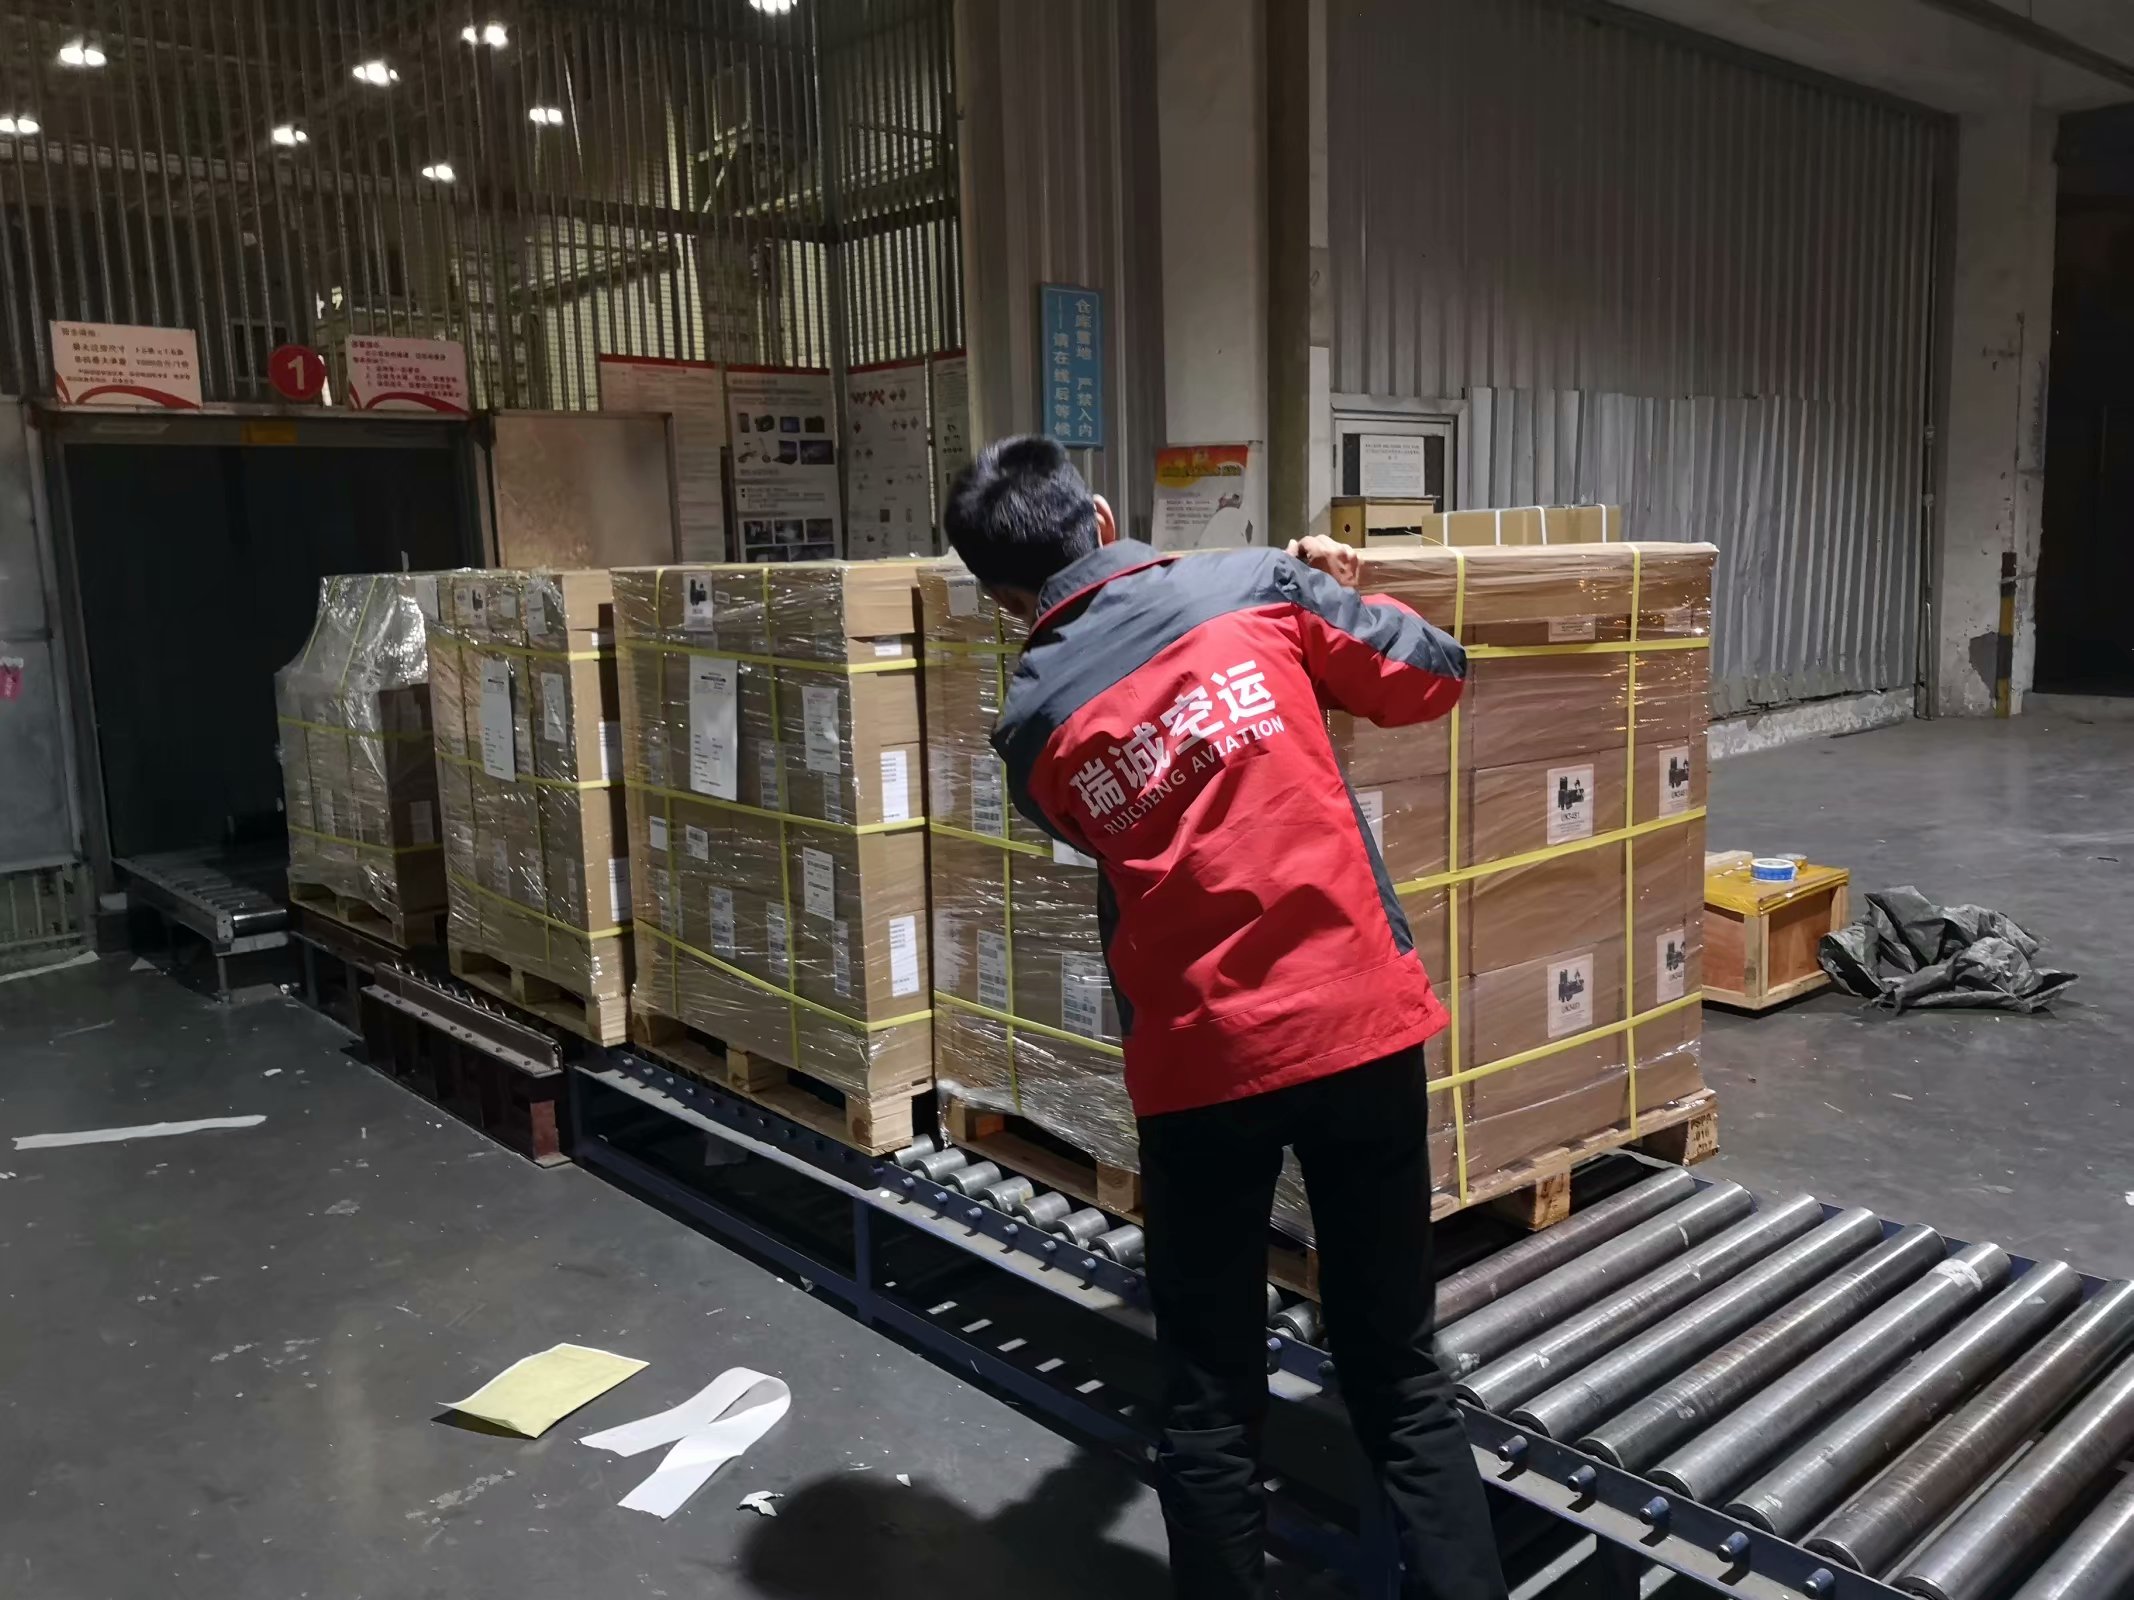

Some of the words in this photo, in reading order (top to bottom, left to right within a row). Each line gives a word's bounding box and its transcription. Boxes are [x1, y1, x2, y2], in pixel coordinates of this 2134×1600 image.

[1075, 298, 1092, 361] 仓库重地
[288, 355, 305, 390] 1
[1077, 377, 1093, 437] 严禁入内
[1069, 659, 1276, 820] 瑞诚空运
[1103, 768, 1187, 835] RUICHENG
[1192, 715, 1285, 774] AVIATION
